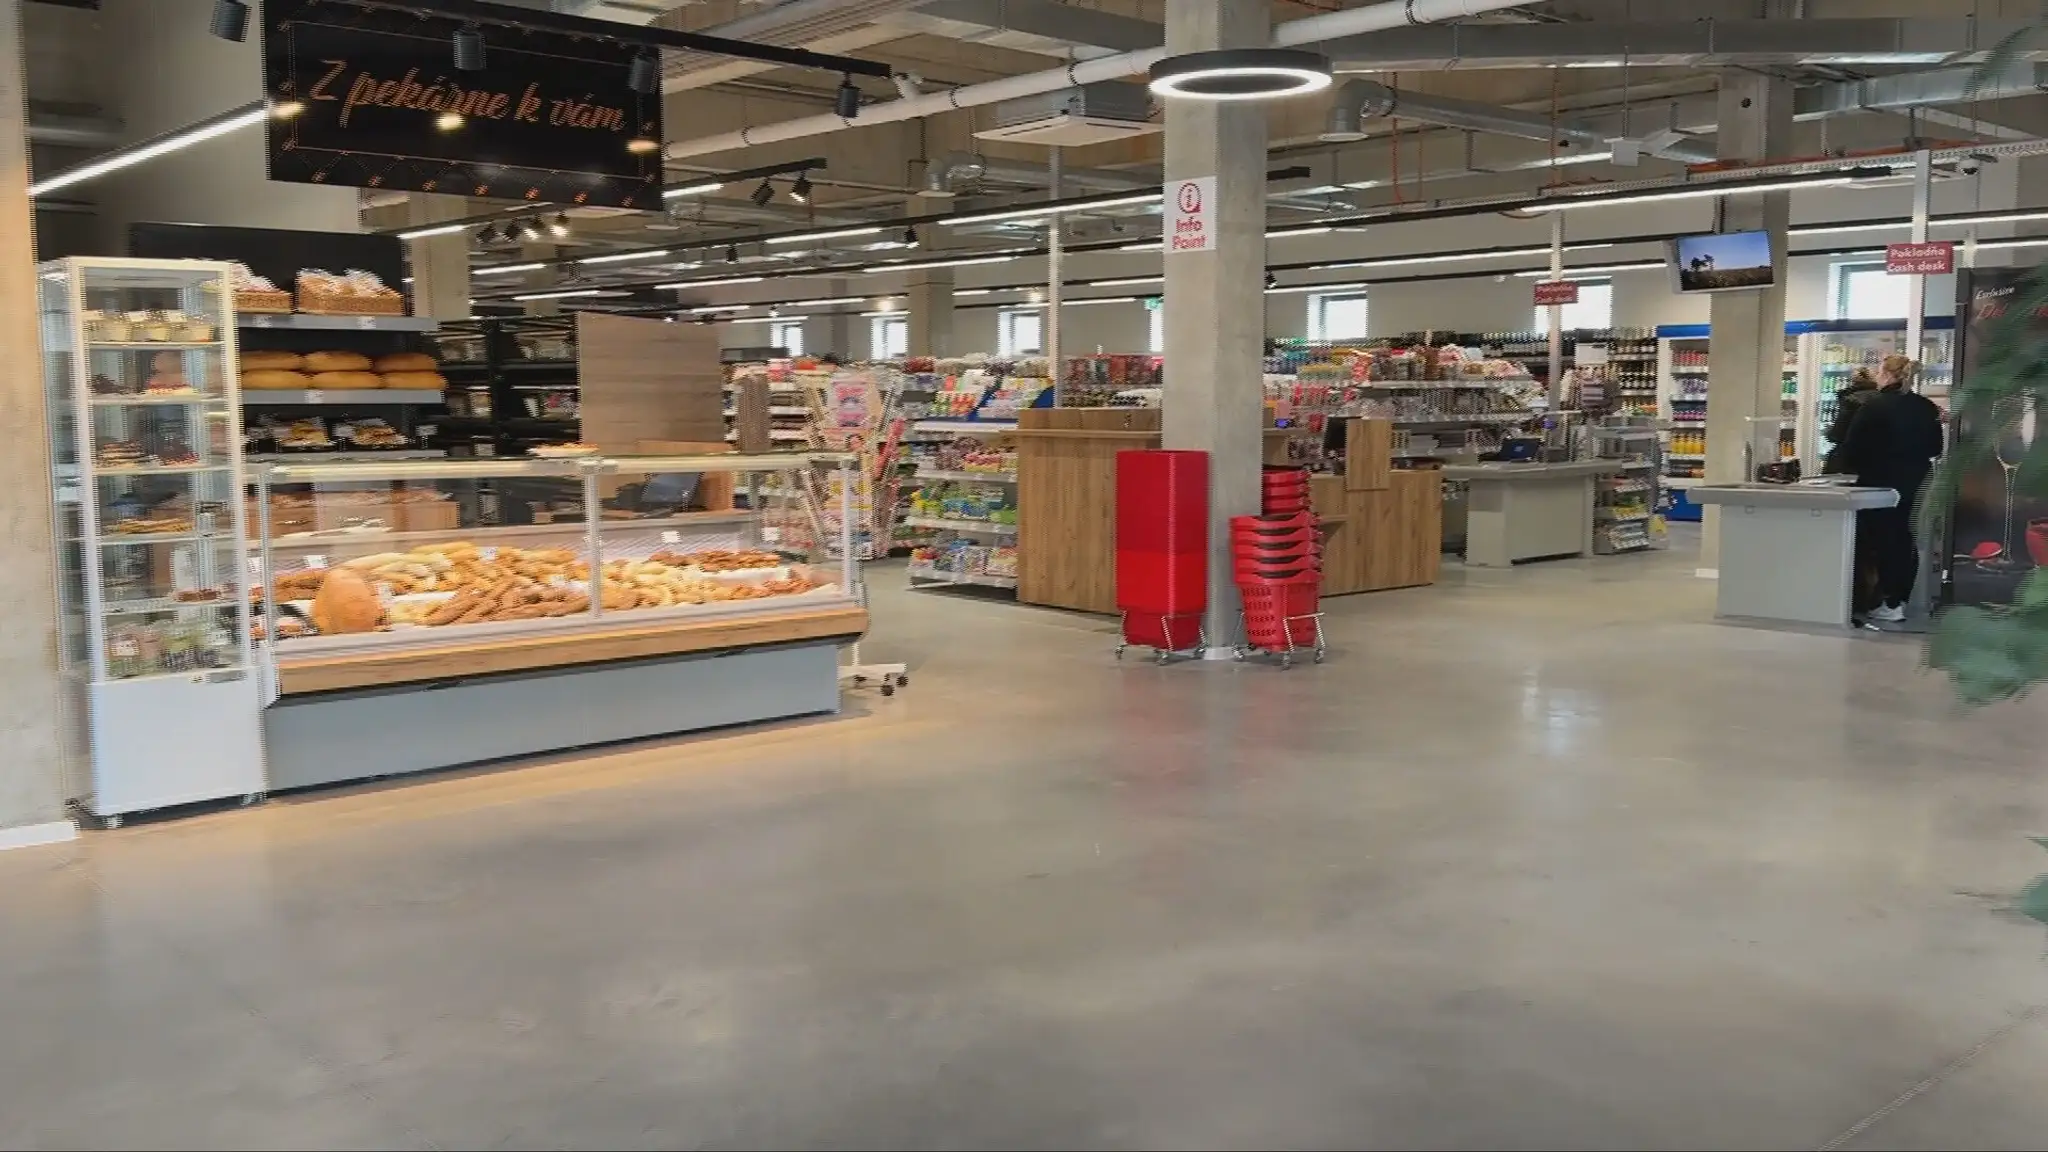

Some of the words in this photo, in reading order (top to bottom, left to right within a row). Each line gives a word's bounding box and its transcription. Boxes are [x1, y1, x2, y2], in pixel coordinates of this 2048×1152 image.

[309, 59, 347, 101] Z
[341, 67, 508, 128] pekárne
[514, 81, 541, 123] k
[550, 93, 627, 132] vám
[1176, 216, 1202, 233] Info
[1172, 234, 1206, 249] Point
[1887, 262, 1915, 273] Cash
[1917, 261, 1946, 272] desk
